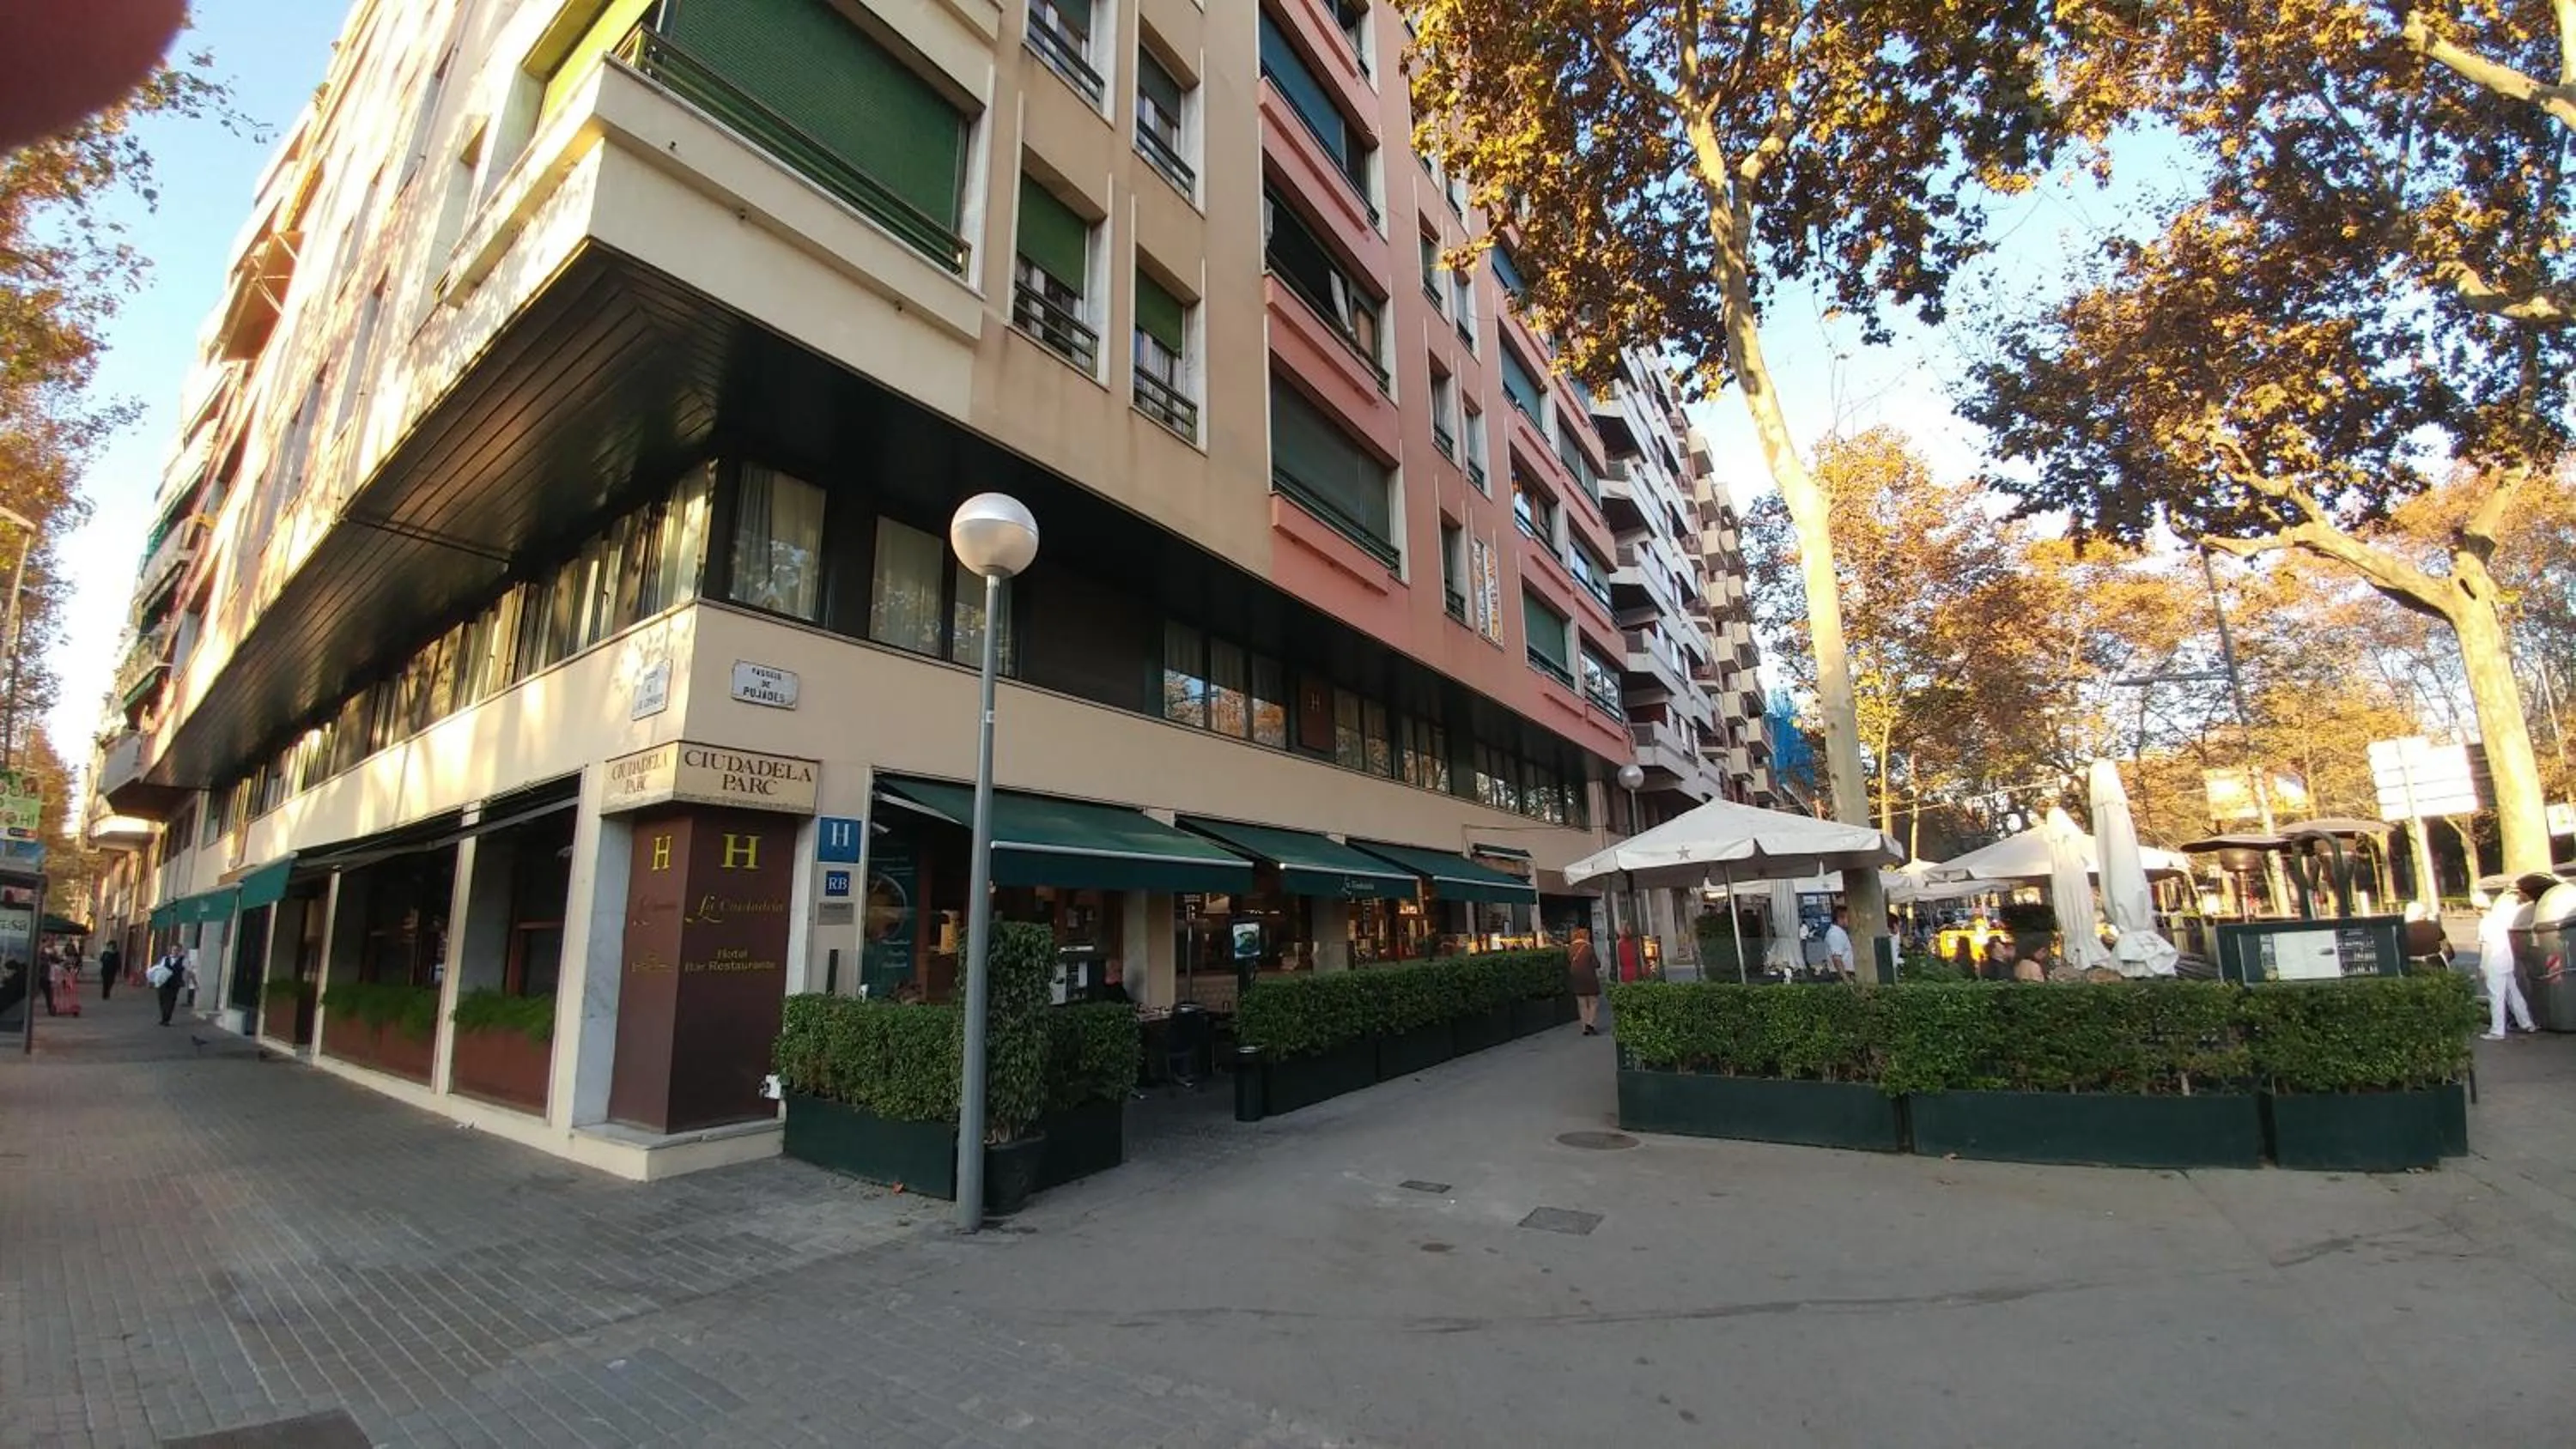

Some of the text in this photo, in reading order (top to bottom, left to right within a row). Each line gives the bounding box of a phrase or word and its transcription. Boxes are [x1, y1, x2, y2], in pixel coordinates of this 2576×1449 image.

[611, 752, 668, 780] CIUDADELA
[684, 749, 812, 782] CIUDADELA
[624, 774, 649, 795] PARC
[721, 774, 779, 796] PARC
[830, 822, 849, 847] H
[652, 835, 671, 870] H
[720, 834, 762, 869] H
[828, 876, 848, 890] RB
